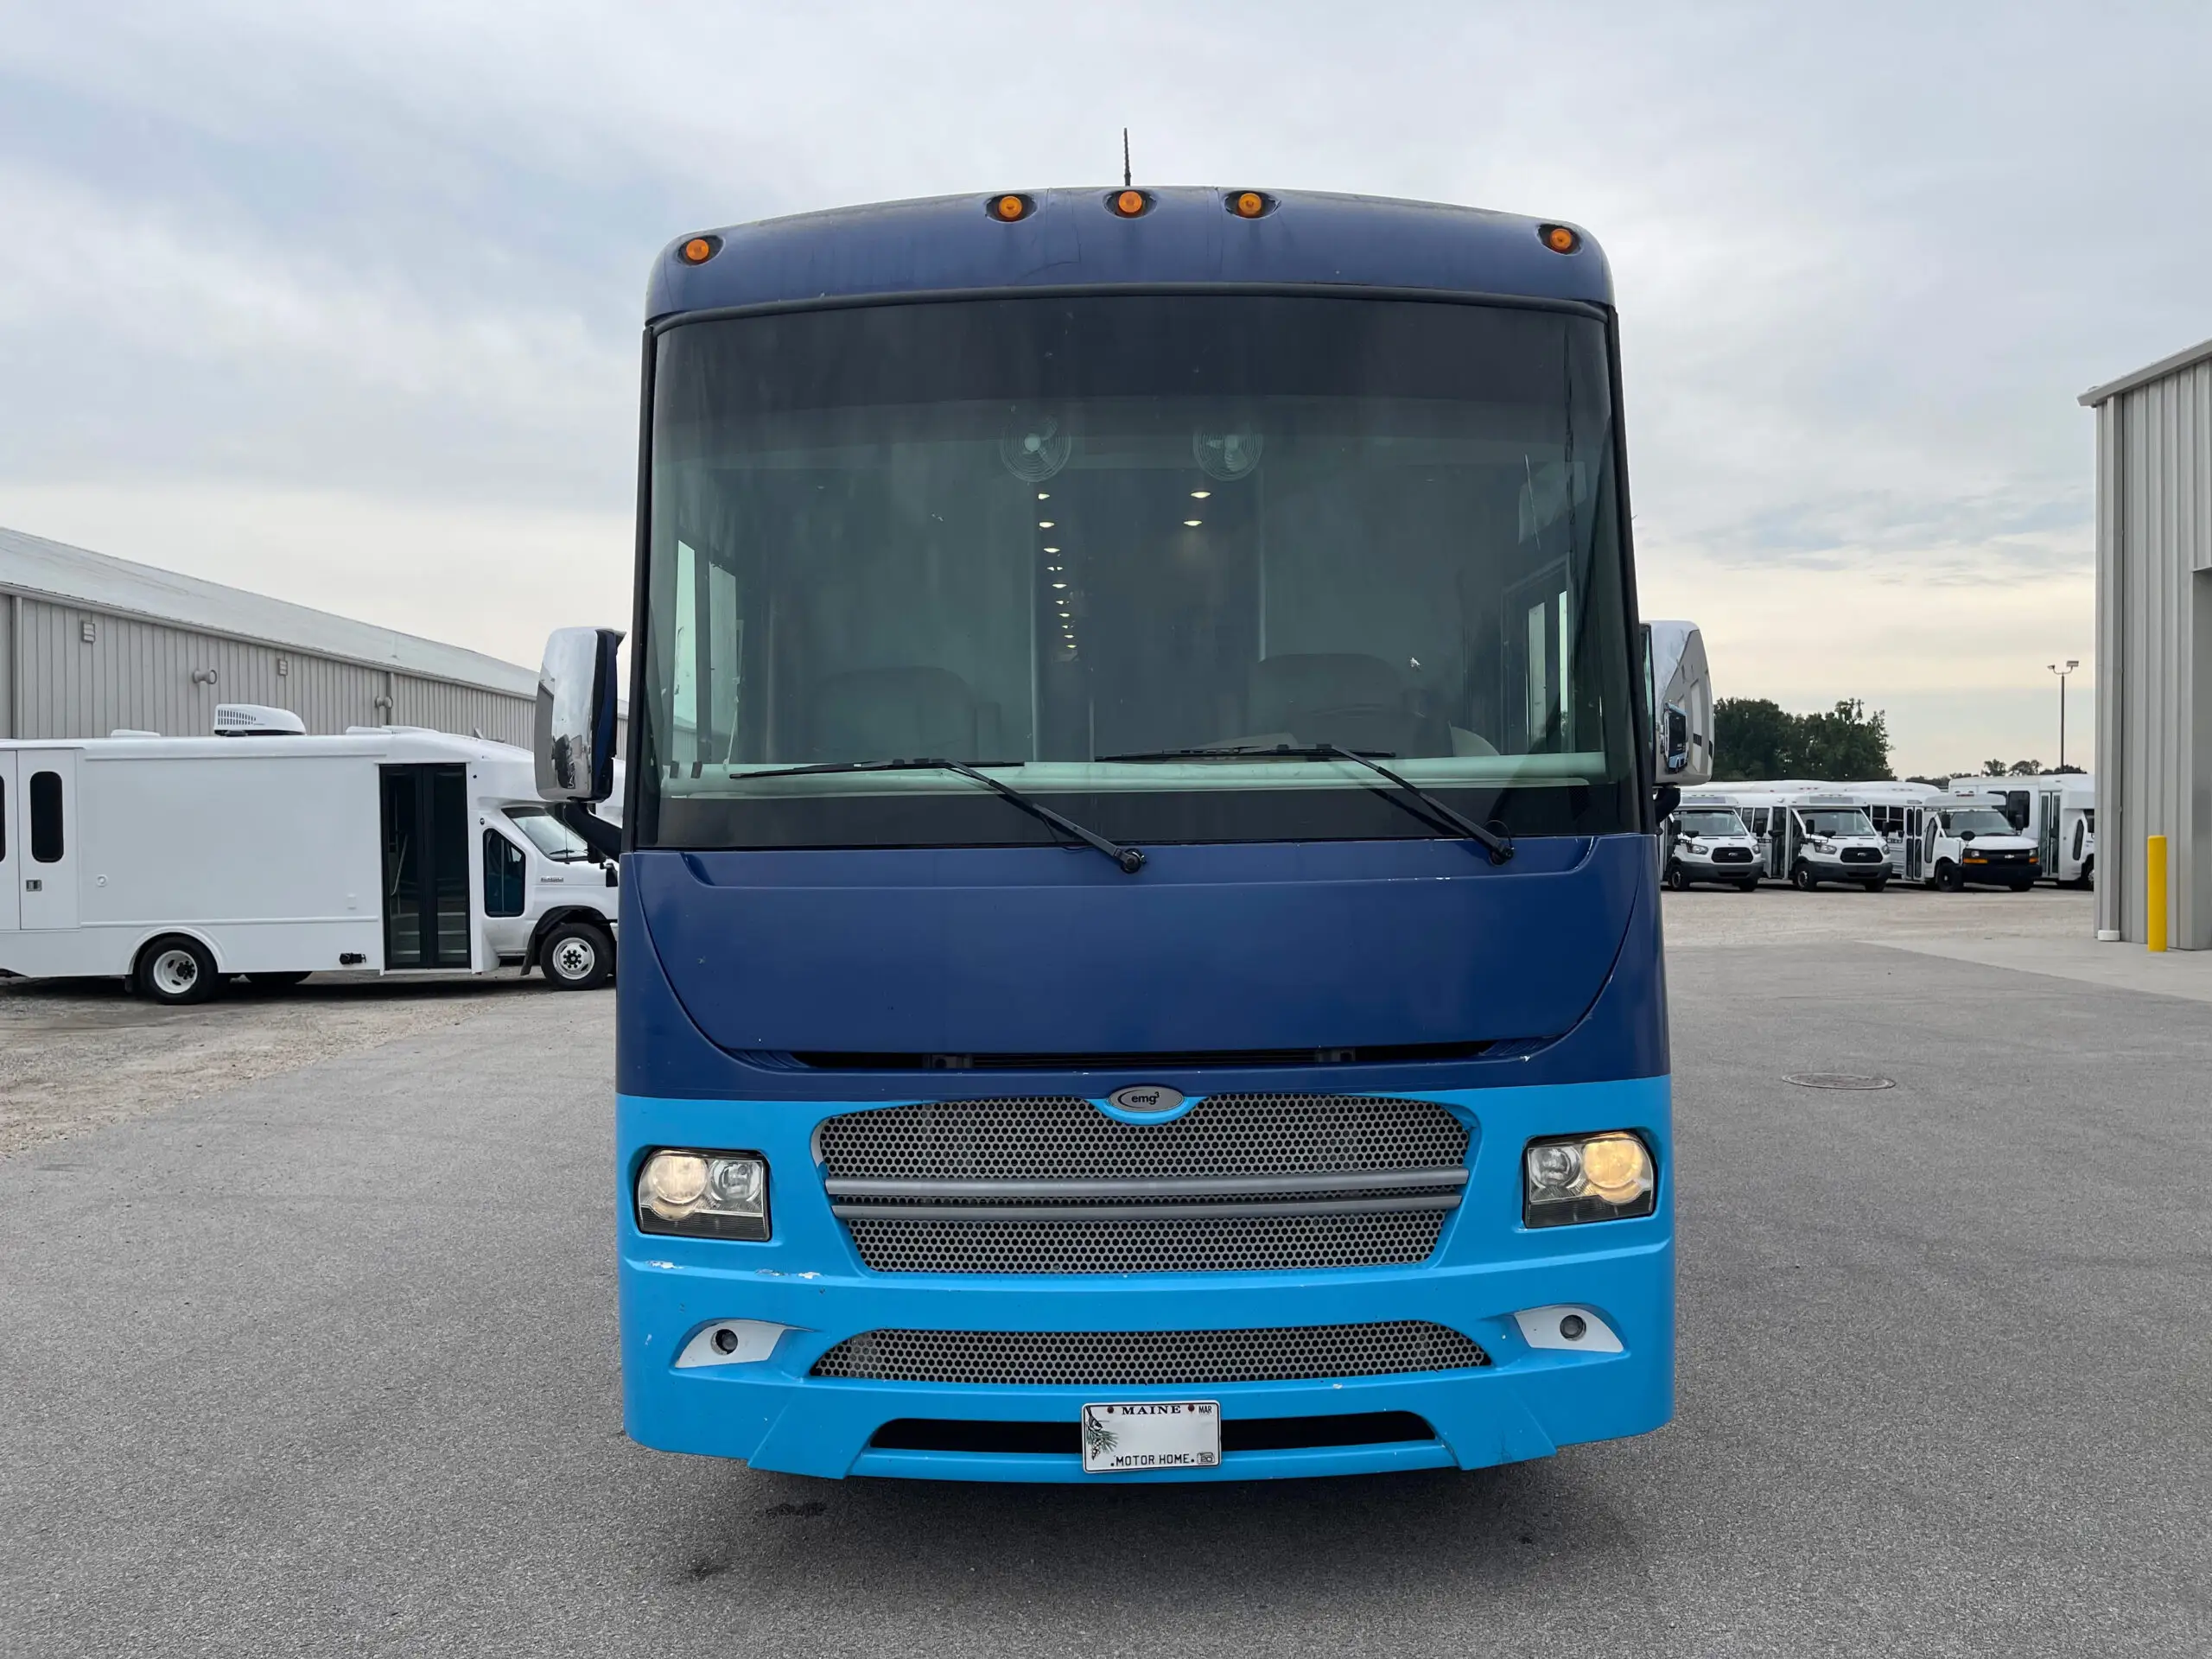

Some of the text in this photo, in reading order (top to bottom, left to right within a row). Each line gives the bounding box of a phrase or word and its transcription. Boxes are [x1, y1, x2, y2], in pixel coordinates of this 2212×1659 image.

[1122, 1405, 1181, 1414] MAINE
[1198, 1405, 1212, 1414] MAR
[1116, 1453, 1190, 1466] MOTOR HOME
